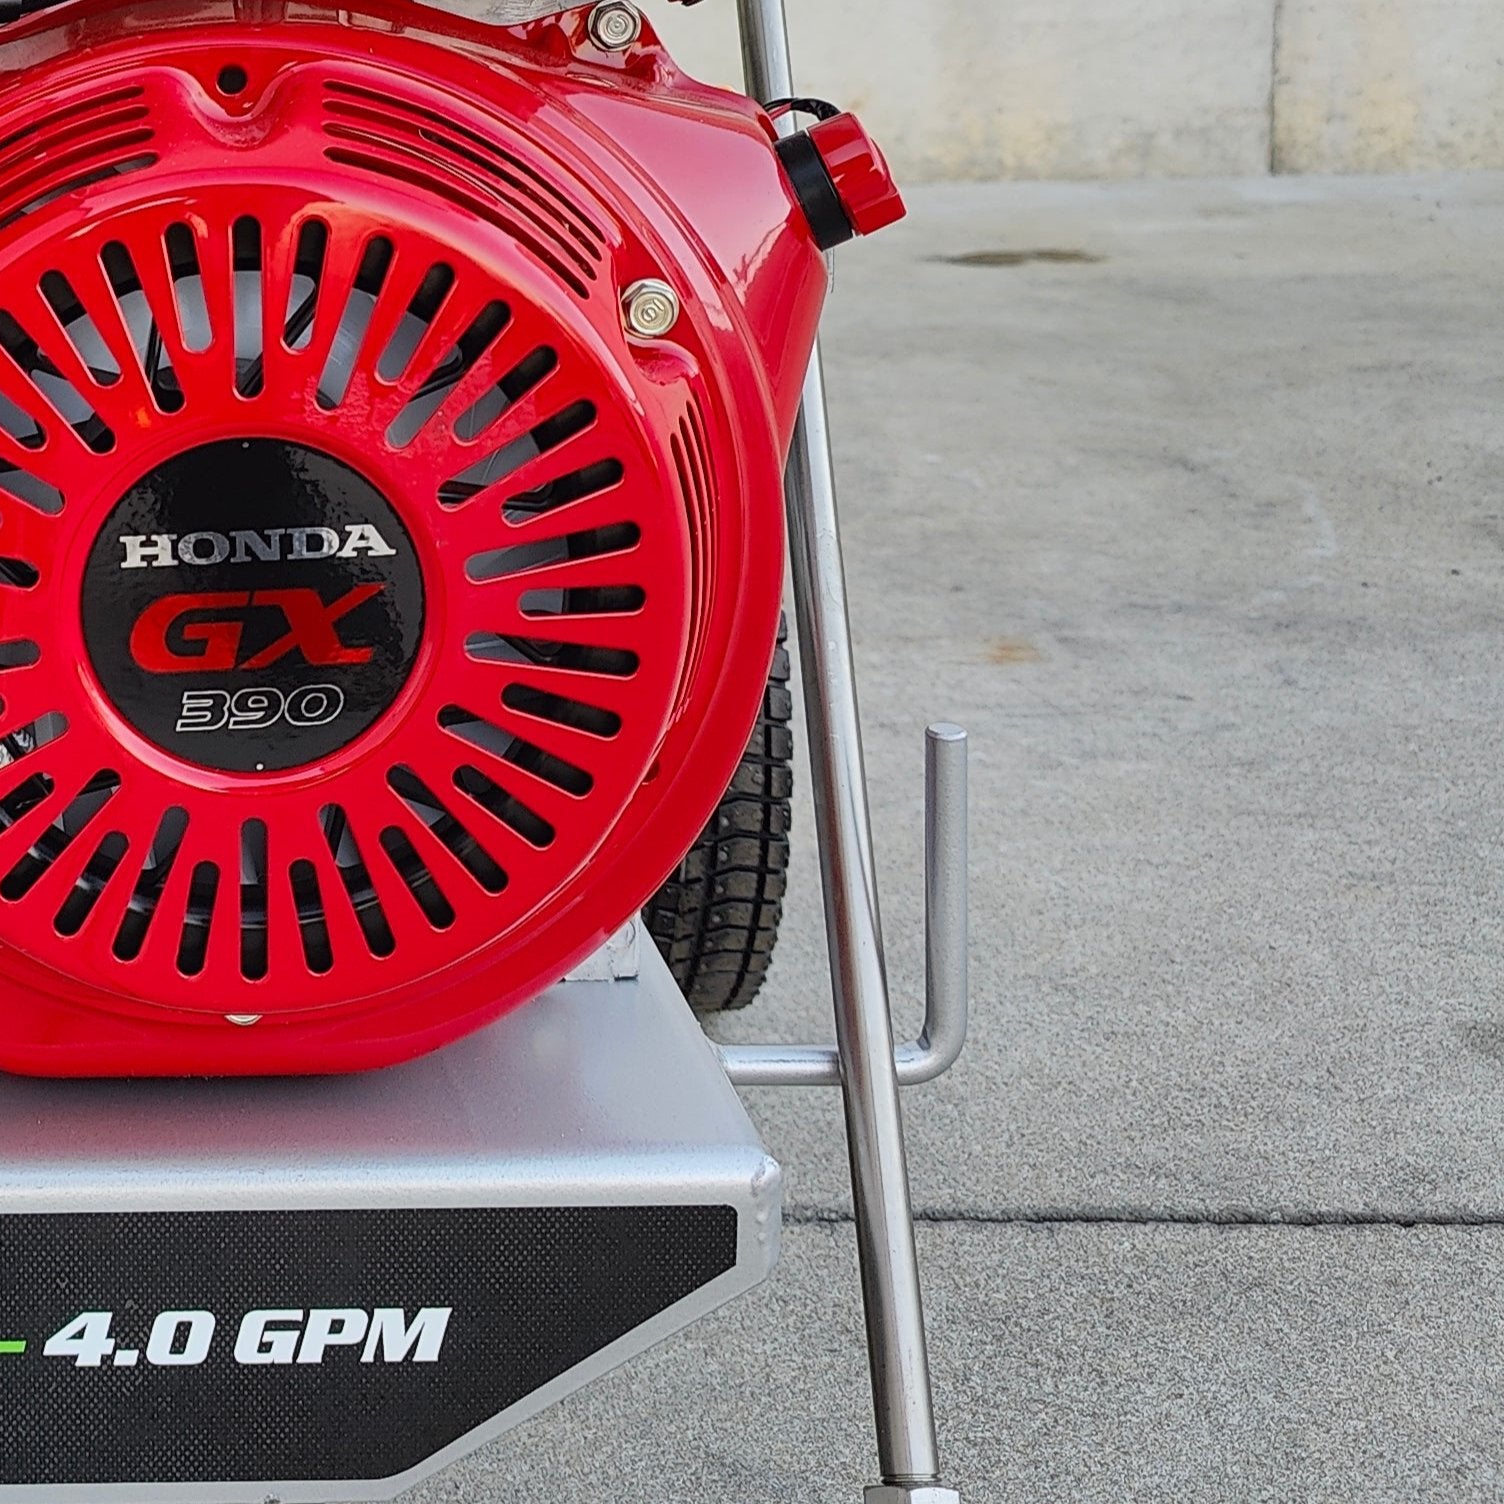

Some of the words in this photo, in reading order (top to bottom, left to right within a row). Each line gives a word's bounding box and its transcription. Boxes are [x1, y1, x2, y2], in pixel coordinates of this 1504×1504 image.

[119, 523, 397, 569] HONDA
[130, 581, 387, 675] GX
[175, 683, 345, 733] 390
[43, 1308, 216, 1369] 4.0
[231, 1306, 454, 1365] GPM
